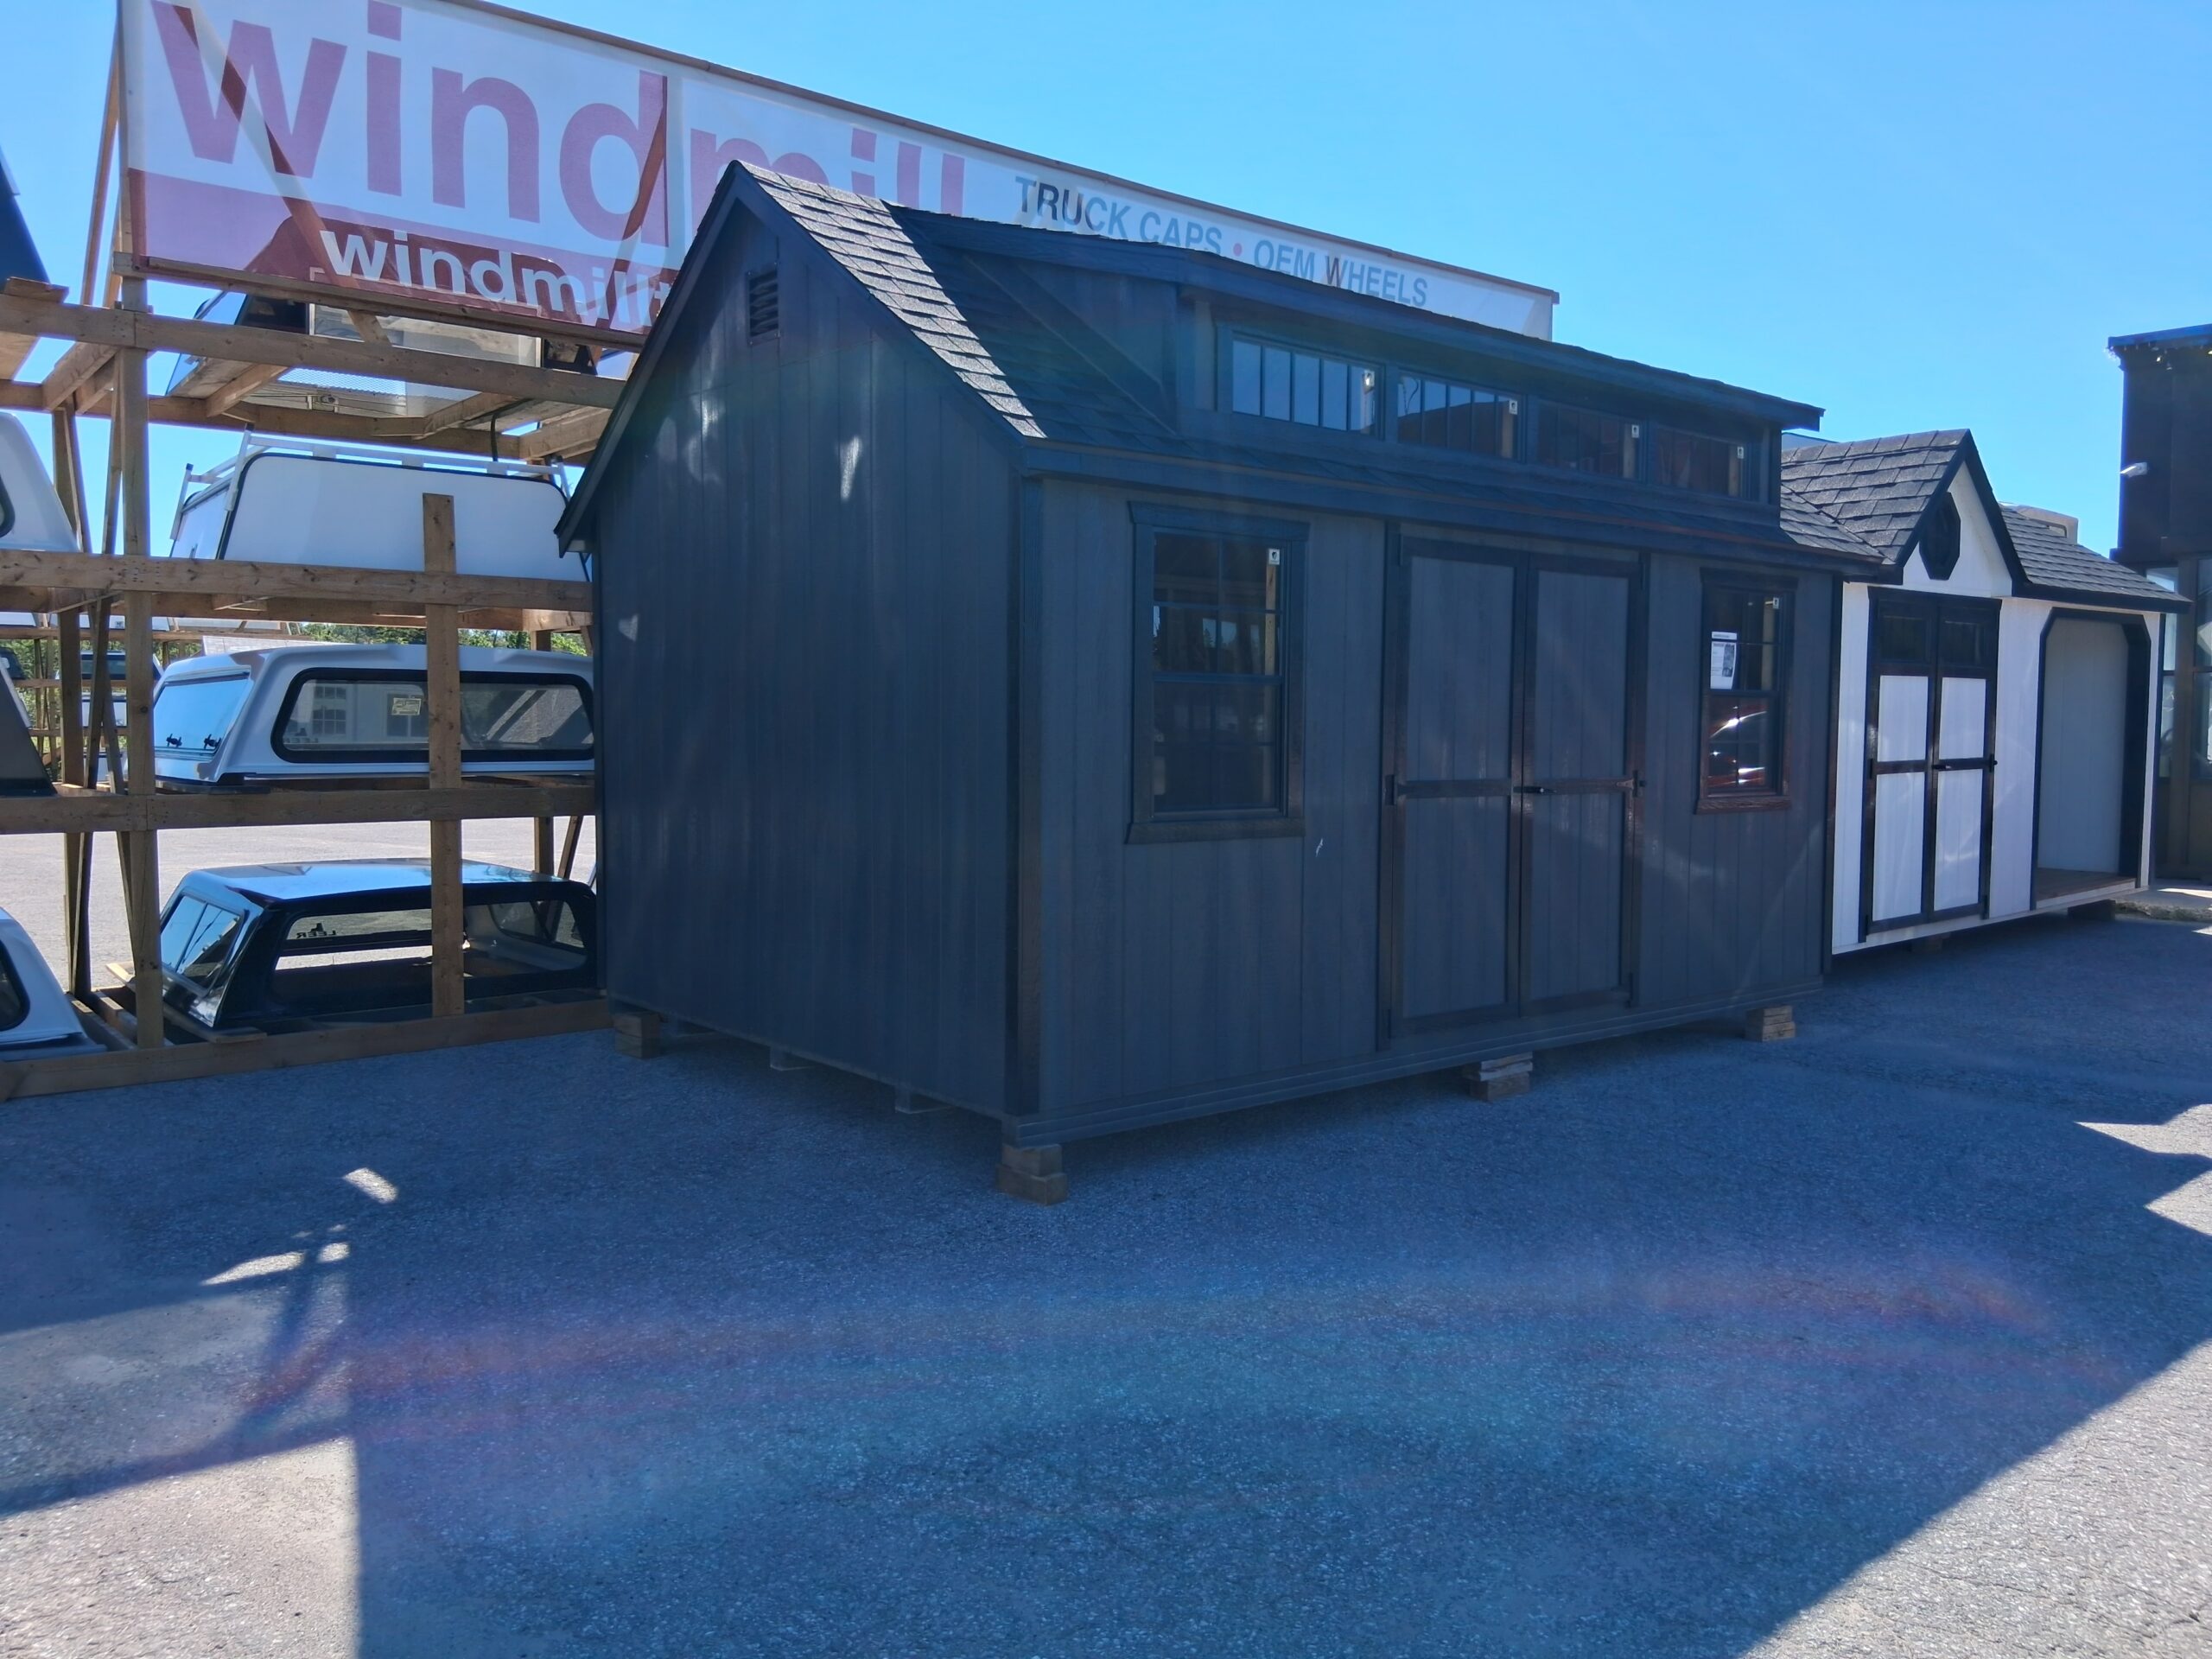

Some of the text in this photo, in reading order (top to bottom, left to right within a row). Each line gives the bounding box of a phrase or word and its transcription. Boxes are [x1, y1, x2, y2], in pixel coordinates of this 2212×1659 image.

[1015, 176, 1428, 307] TRUCK CAPS OEM WHEELS
